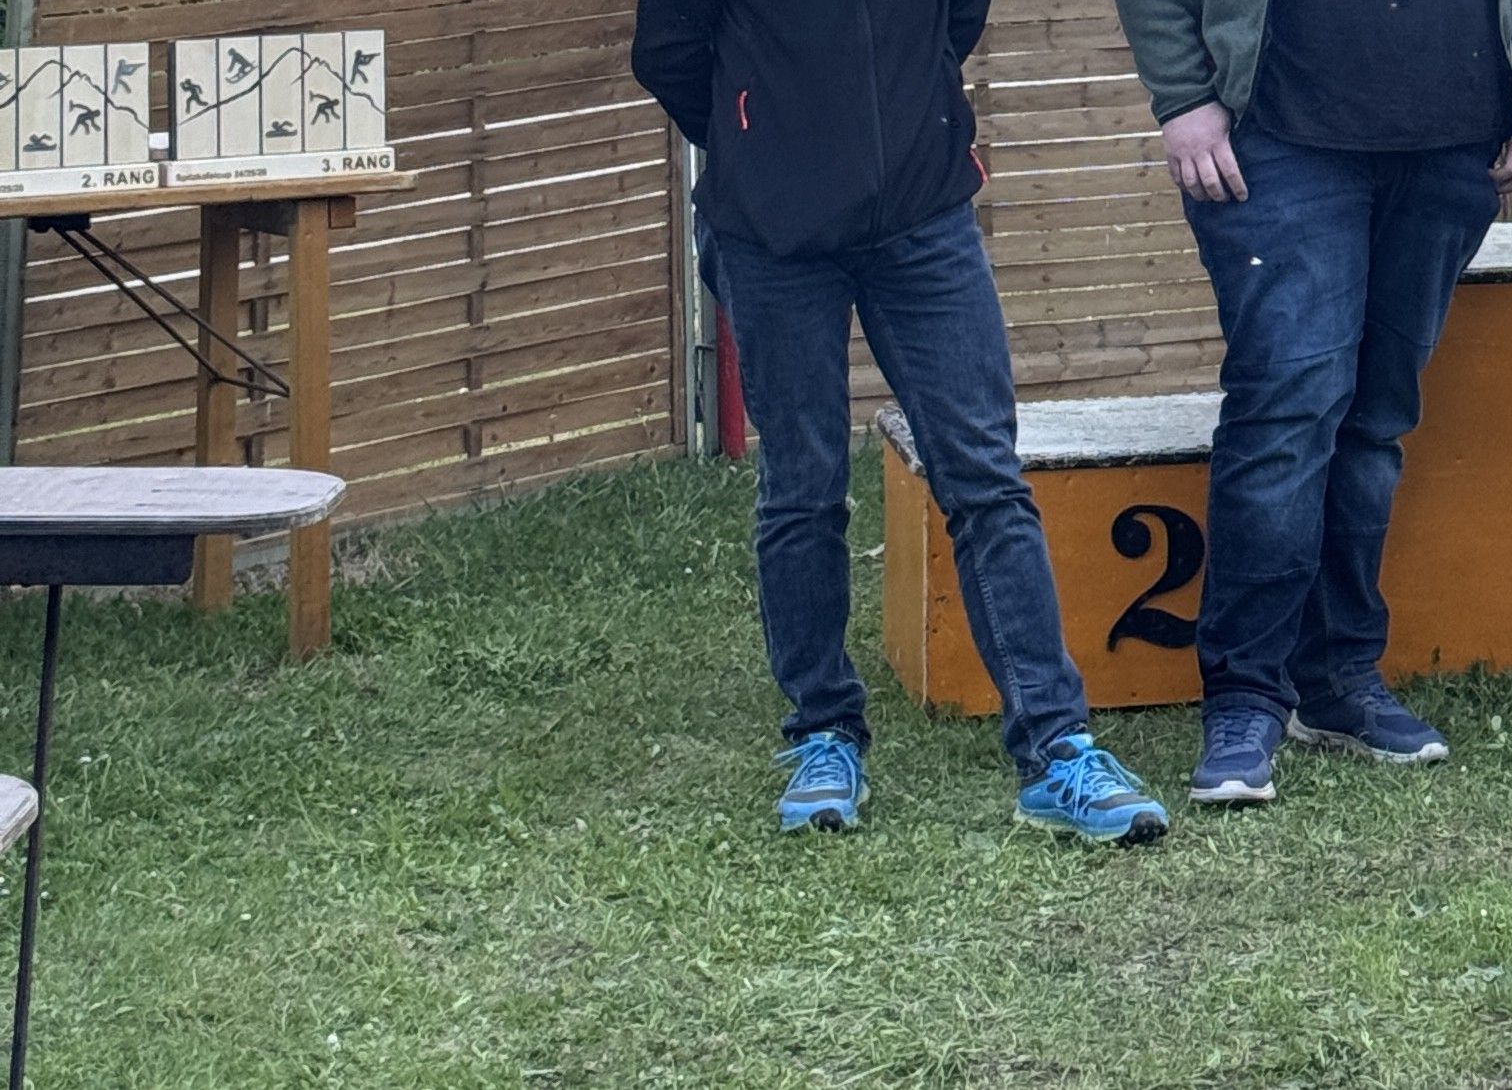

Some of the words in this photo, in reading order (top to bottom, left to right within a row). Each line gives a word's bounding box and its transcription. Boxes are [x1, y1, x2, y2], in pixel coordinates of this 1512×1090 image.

[321, 158, 337, 173] 3.
[342, 154, 391, 171] RANG
[81, 173, 98, 189] 2.
[103, 169, 155, 187] RANG
[1106, 504, 1206, 653] 2
